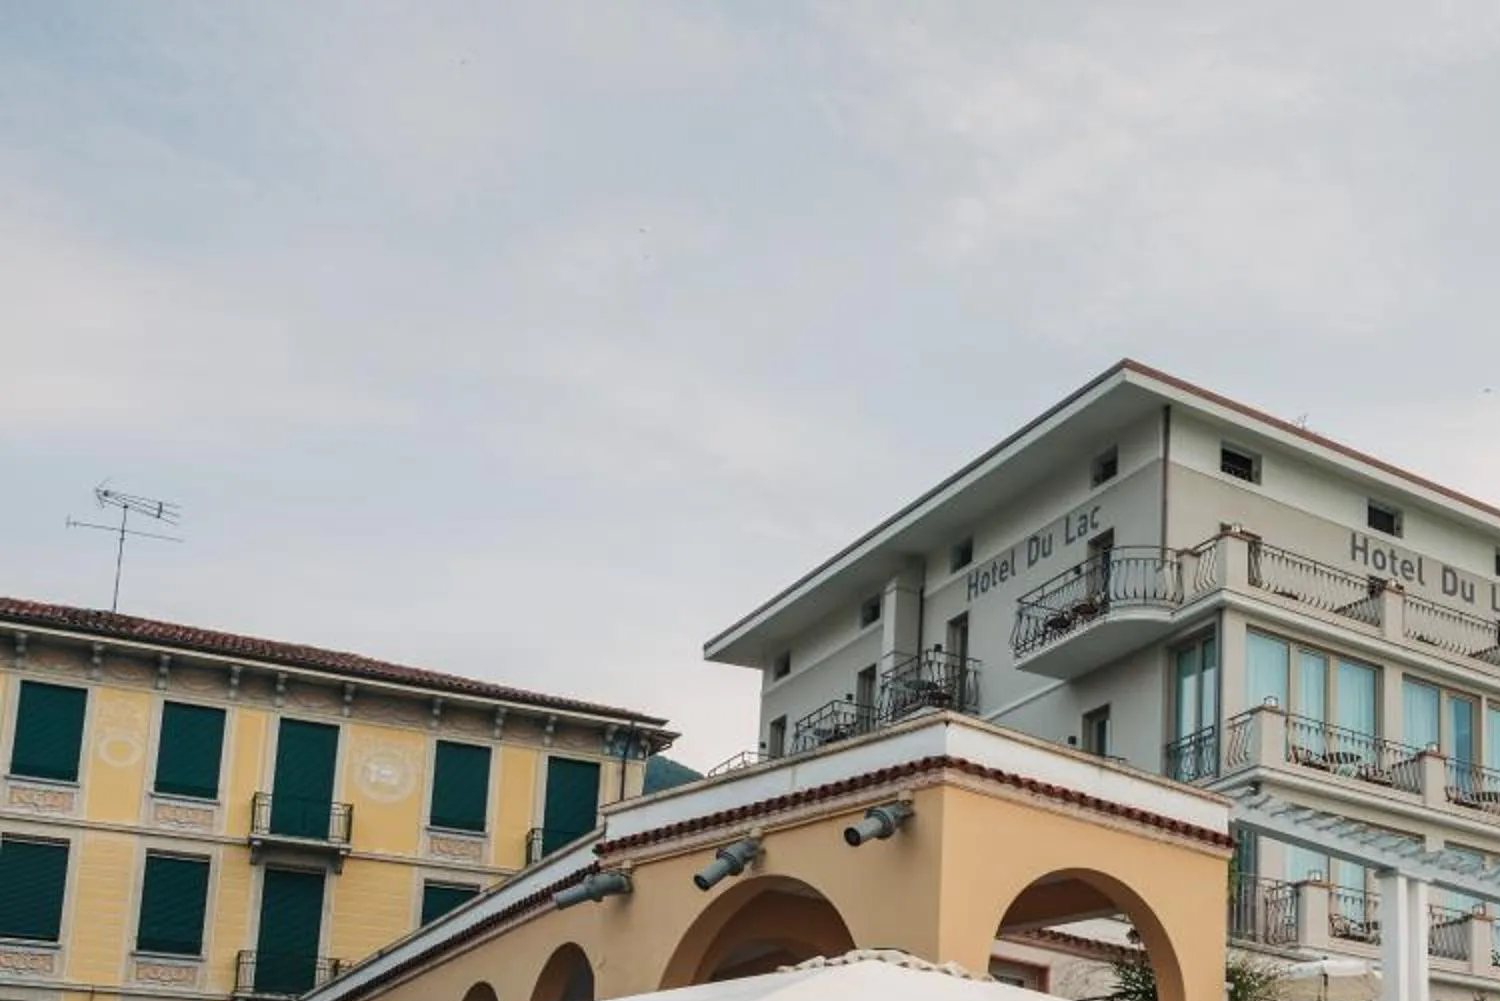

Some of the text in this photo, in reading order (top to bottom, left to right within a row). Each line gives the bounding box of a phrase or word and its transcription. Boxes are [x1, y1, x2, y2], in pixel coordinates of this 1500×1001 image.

[967, 505, 1102, 601] Hotel Du Lac
[1350, 532, 1425, 586] Hotel
[1441, 564, 1476, 603] Du
